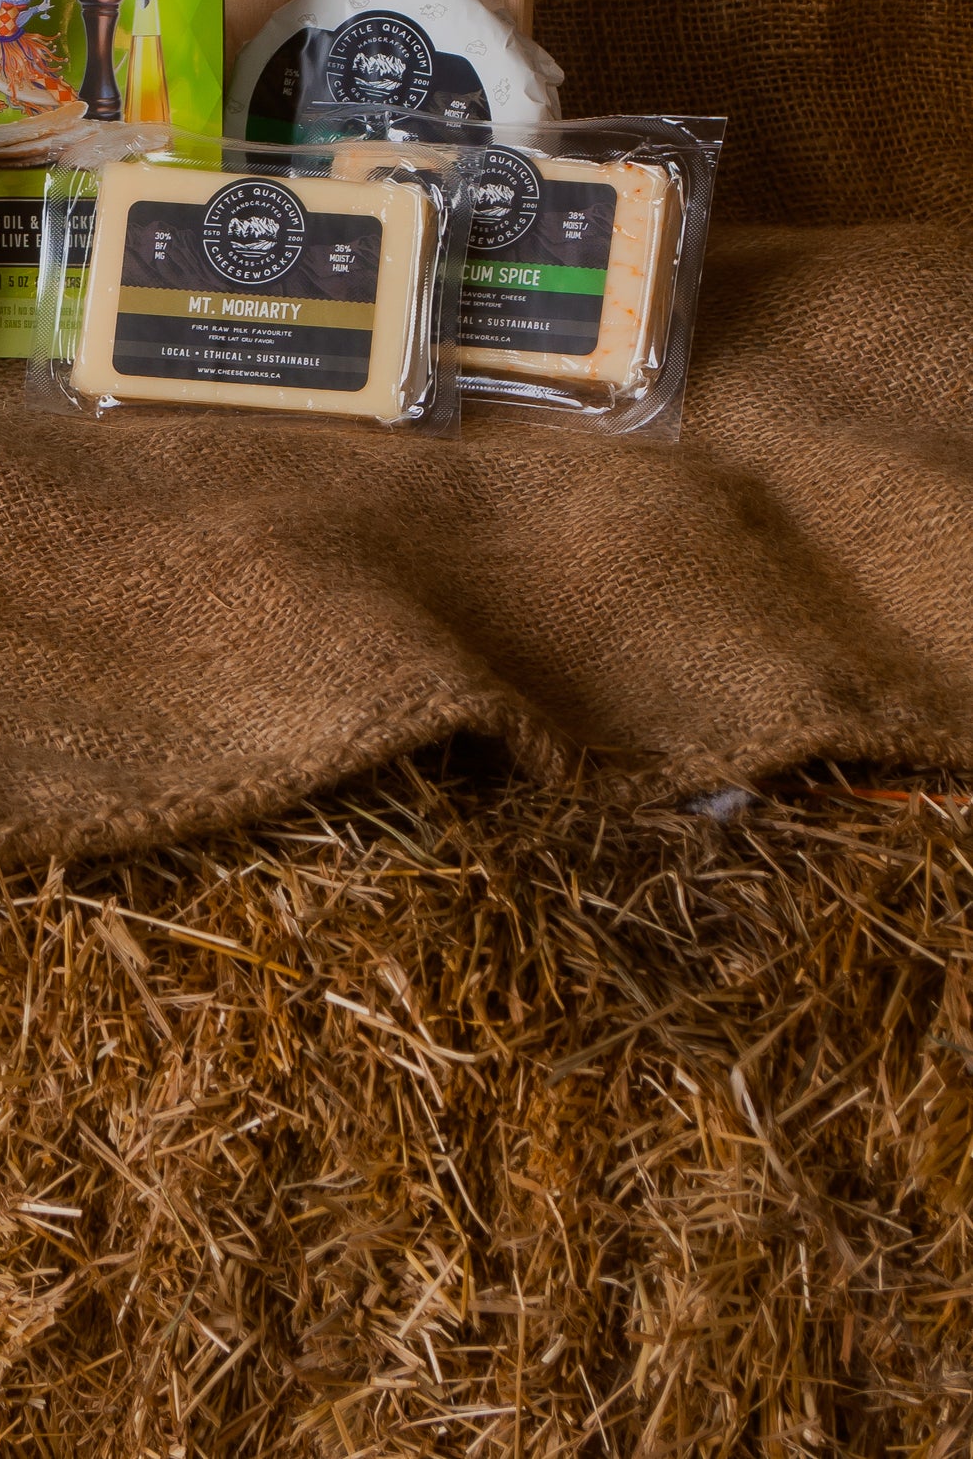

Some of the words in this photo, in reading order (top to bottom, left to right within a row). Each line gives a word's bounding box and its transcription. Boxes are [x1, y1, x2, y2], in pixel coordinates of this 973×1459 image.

[337, 24, 373, 53] LITTLE
[382, 23, 427, 68] QUALICUM
[357, 36, 409, 58] HANDCRAFTED
[327, 62, 345, 70] ESTD
[413, 78, 430, 86] 2001
[489, 155, 536, 194] QUALICUM
[211, 190, 245, 220] LITTLE
[253, 188, 300, 226] QUALICUM
[230, 200, 282, 219] HANDCRAFTED
[3, 215, 24, 230] OIL
[30, 215, 40, 230] &
[154, 231, 171, 240] 30%
[155, 242, 167, 250] BF/
[155, 251, 165, 260] MG
[211, 246, 293, 279] CHEESEWORKS
[228, 250, 276, 267] GRASS-FED
[8, 276, 14, 287] 5
[18, 276, 28, 287] OZ
[498, 268, 541, 286] SPICE
[501, 294, 527, 302] CHEESE
[188, 296, 216, 315] MT.
[222, 298, 303, 321] MORIARTY
[191, 324, 209, 332] FIRM
[212, 325, 230, 333] RAW
[233, 327, 248, 335] MILK
[252, 328, 293, 338] FAVOURITE
[487, 317, 551, 331] SUSTAINABLE
[208, 334, 226, 342] FERME
[161, 346, 191, 358] LOCAL
[203, 349, 243, 362] ETHICAL
[256, 353, 321, 367] SUSTAINABLE
[197, 367, 282, 379] WWW.CHEESEWORKS.CA
